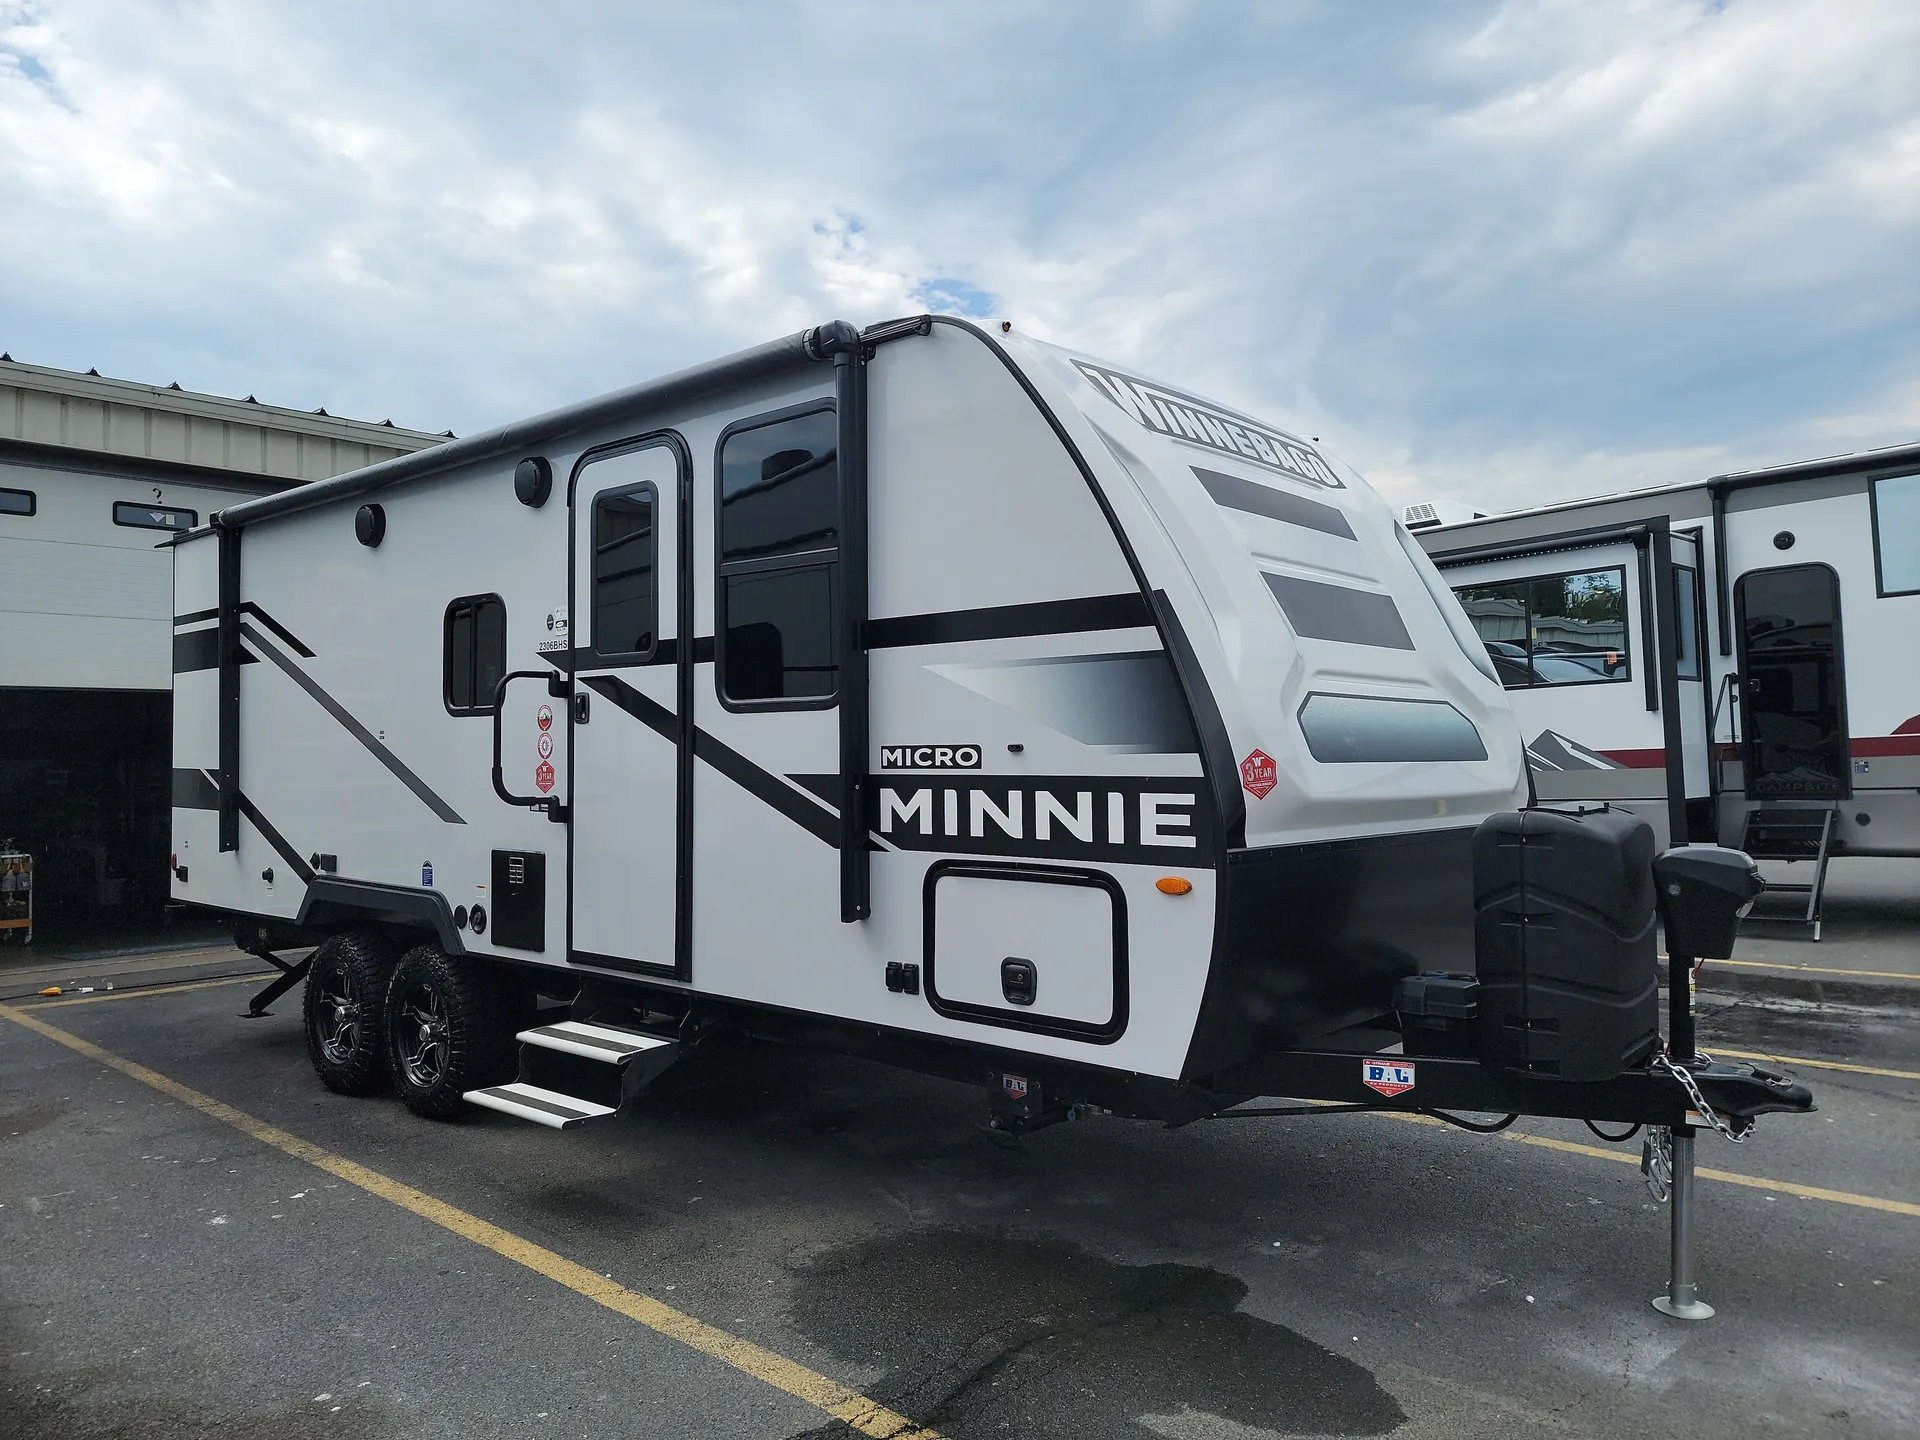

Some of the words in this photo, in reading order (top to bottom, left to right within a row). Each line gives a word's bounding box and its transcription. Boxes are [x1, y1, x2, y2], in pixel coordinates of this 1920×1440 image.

[1079, 365, 1339, 486] WINNEBAGO
[538, 639, 568, 651] 2306BHS
[881, 747, 979, 767] MICRO
[1245, 762, 1255, 782] 3
[1254, 767, 1273, 779] YEAR
[879, 787, 1197, 848] MINNIE
[1368, 1066, 1409, 1083] BAL
